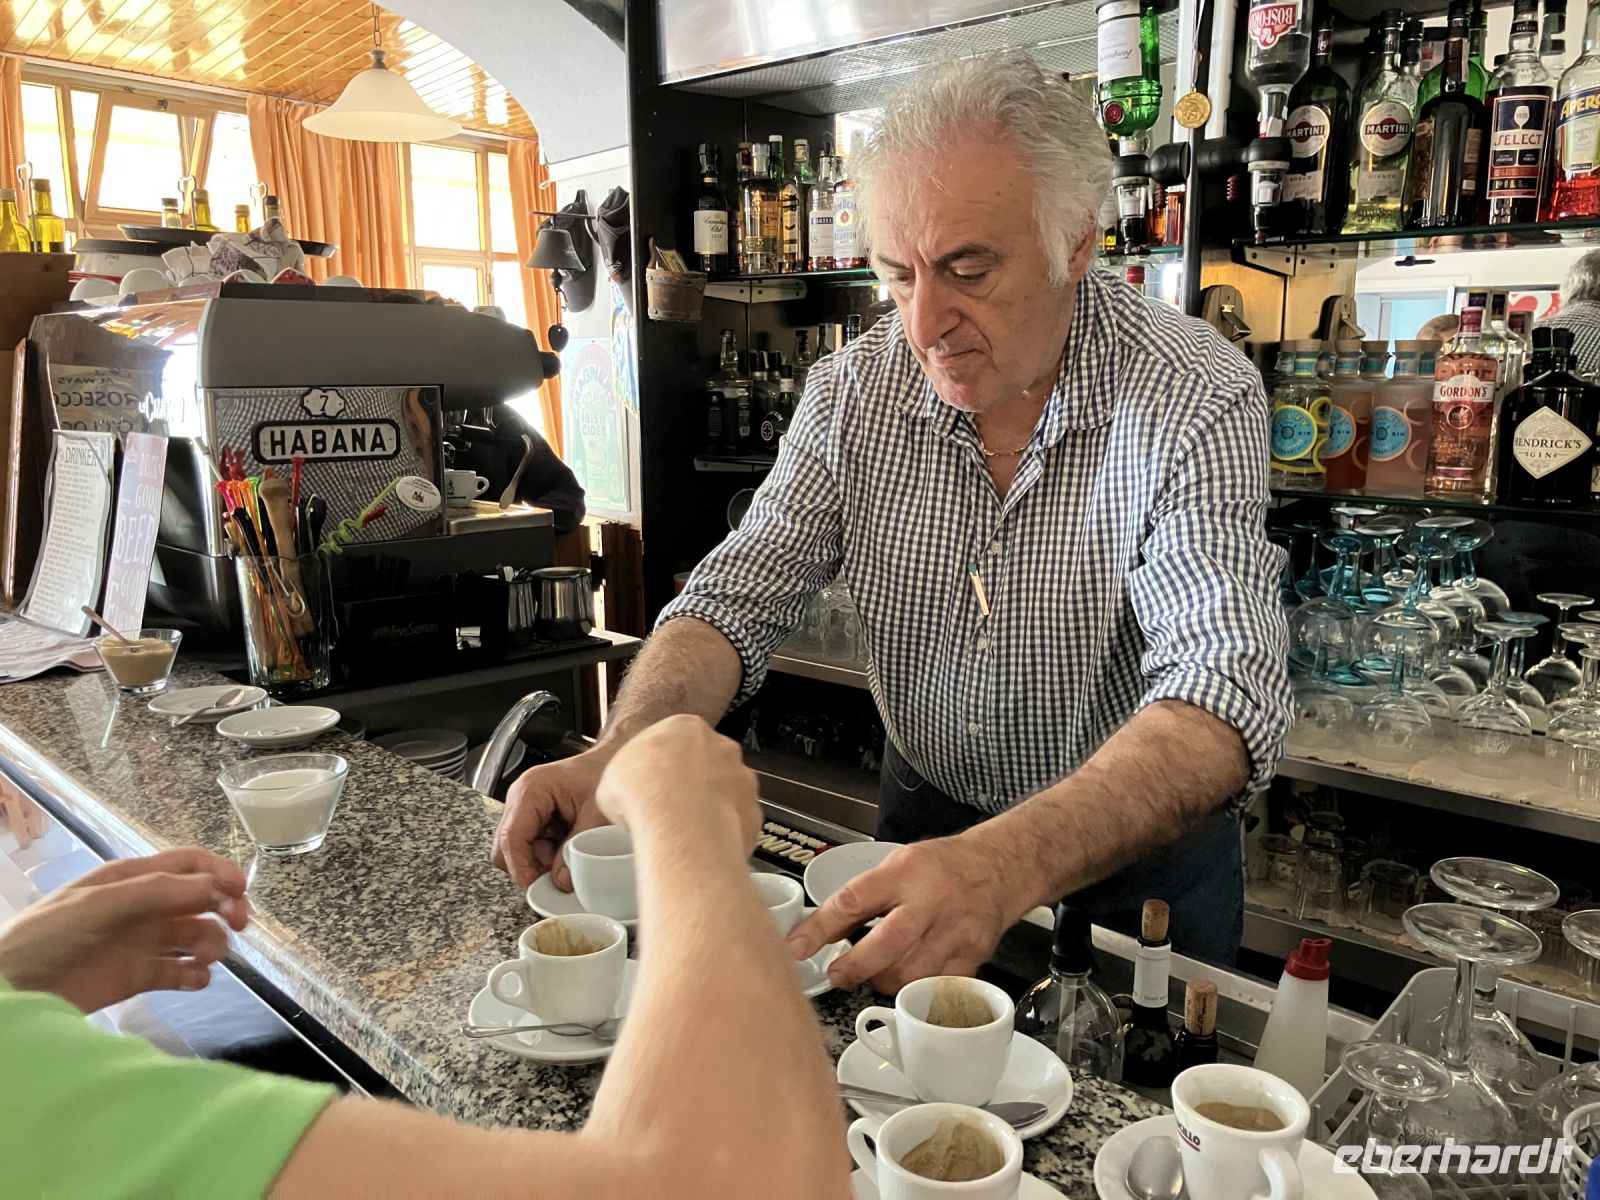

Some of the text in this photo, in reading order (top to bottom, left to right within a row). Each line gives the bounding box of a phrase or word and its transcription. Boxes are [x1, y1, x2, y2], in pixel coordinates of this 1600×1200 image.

[1286, 125, 1325, 137] MARTINI
[1366, 124, 1409, 134] MARTINI
[1494, 133, 1542, 146] SELECT
[1439, 385, 1488, 398] GORDON'S
[319, 395, 329, 411] 7
[270, 427, 387, 456] HABANA
[116, 511, 155, 566] BEER
